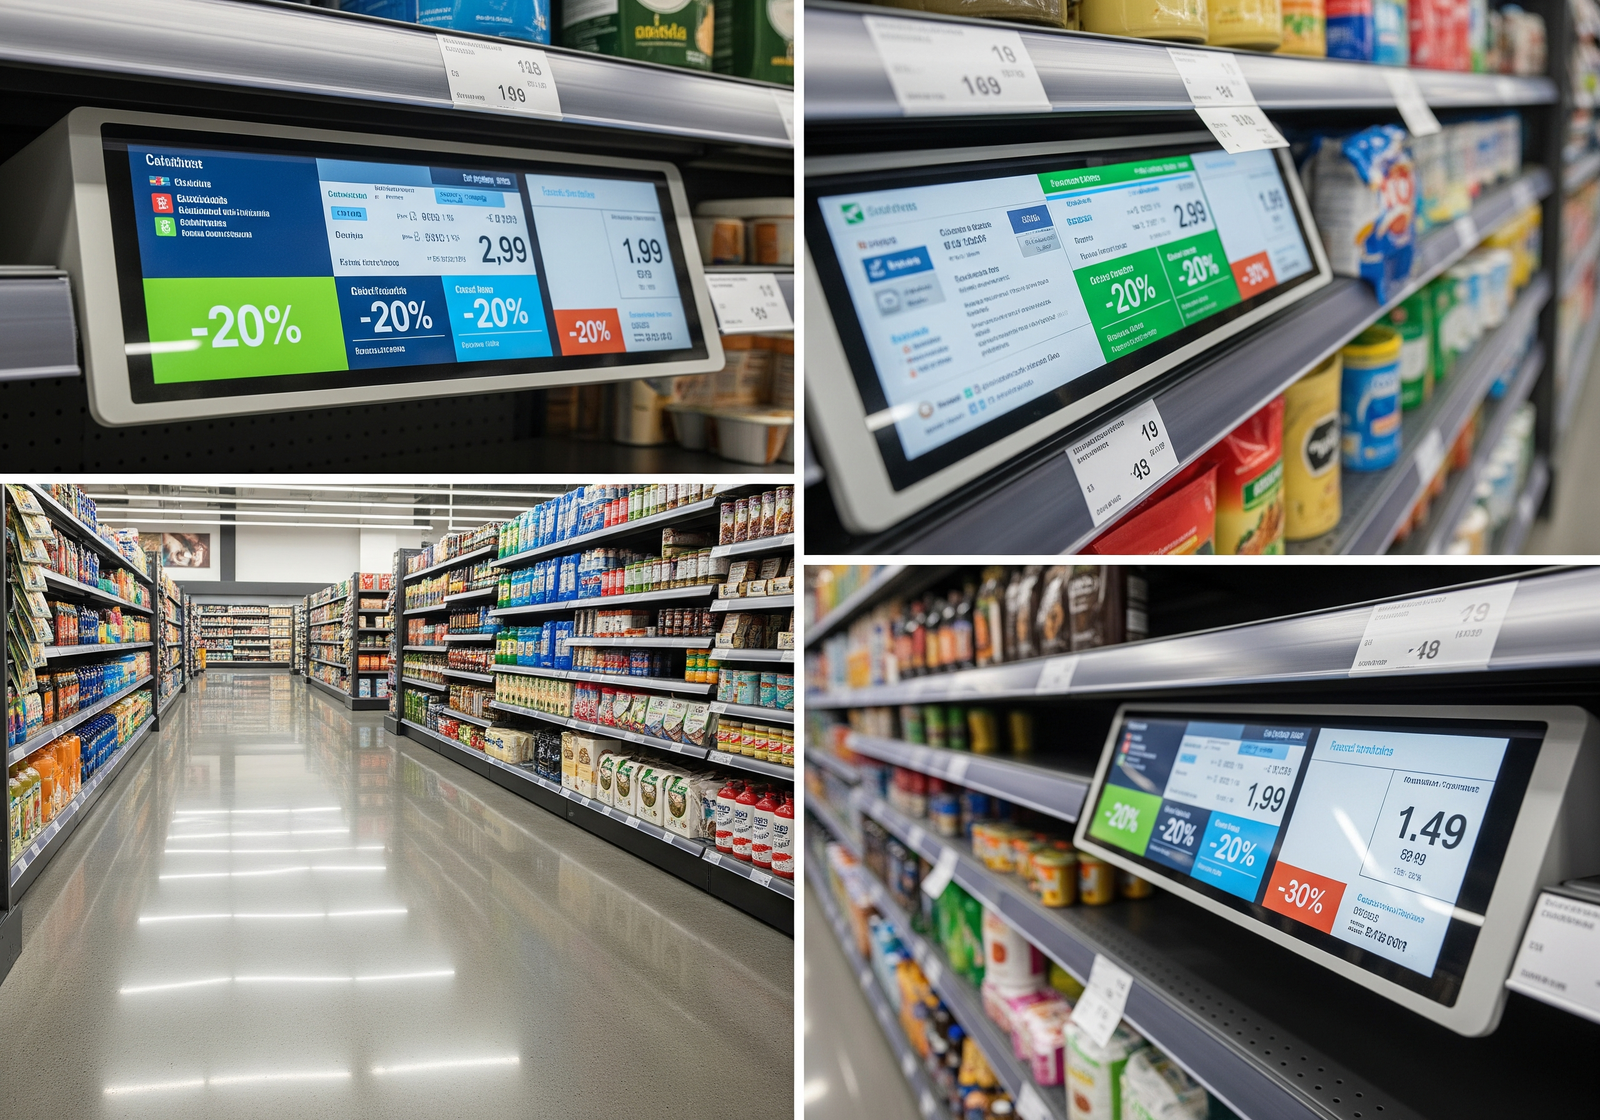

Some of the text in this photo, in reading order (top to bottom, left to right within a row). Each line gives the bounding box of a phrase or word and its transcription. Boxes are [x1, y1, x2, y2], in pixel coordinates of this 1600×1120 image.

[497, 84, 526, 104] 199
[478, 235, 527, 265] 2,99
[622, 237, 663, 264] 1.99
[1178, 253, 1220, 287] -20%
[1105, 274, 1156, 315] -20%
[191, 304, 302, 348] -20%
[360, 299, 433, 333] -20%
[463, 296, 529, 329] -20%
[569, 319, 611, 344] -20%
[1141, 419, 1159, 441] 19
[1247, 782, 1286, 812] 1,99
[1104, 801, 1141, 834] -20%
[1158, 817, 1197, 847] -20%
[1398, 805, 1467, 850] 1.49
[1209, 833, 1257, 867] -20%
[1277, 878, 1327, 915] -30%
